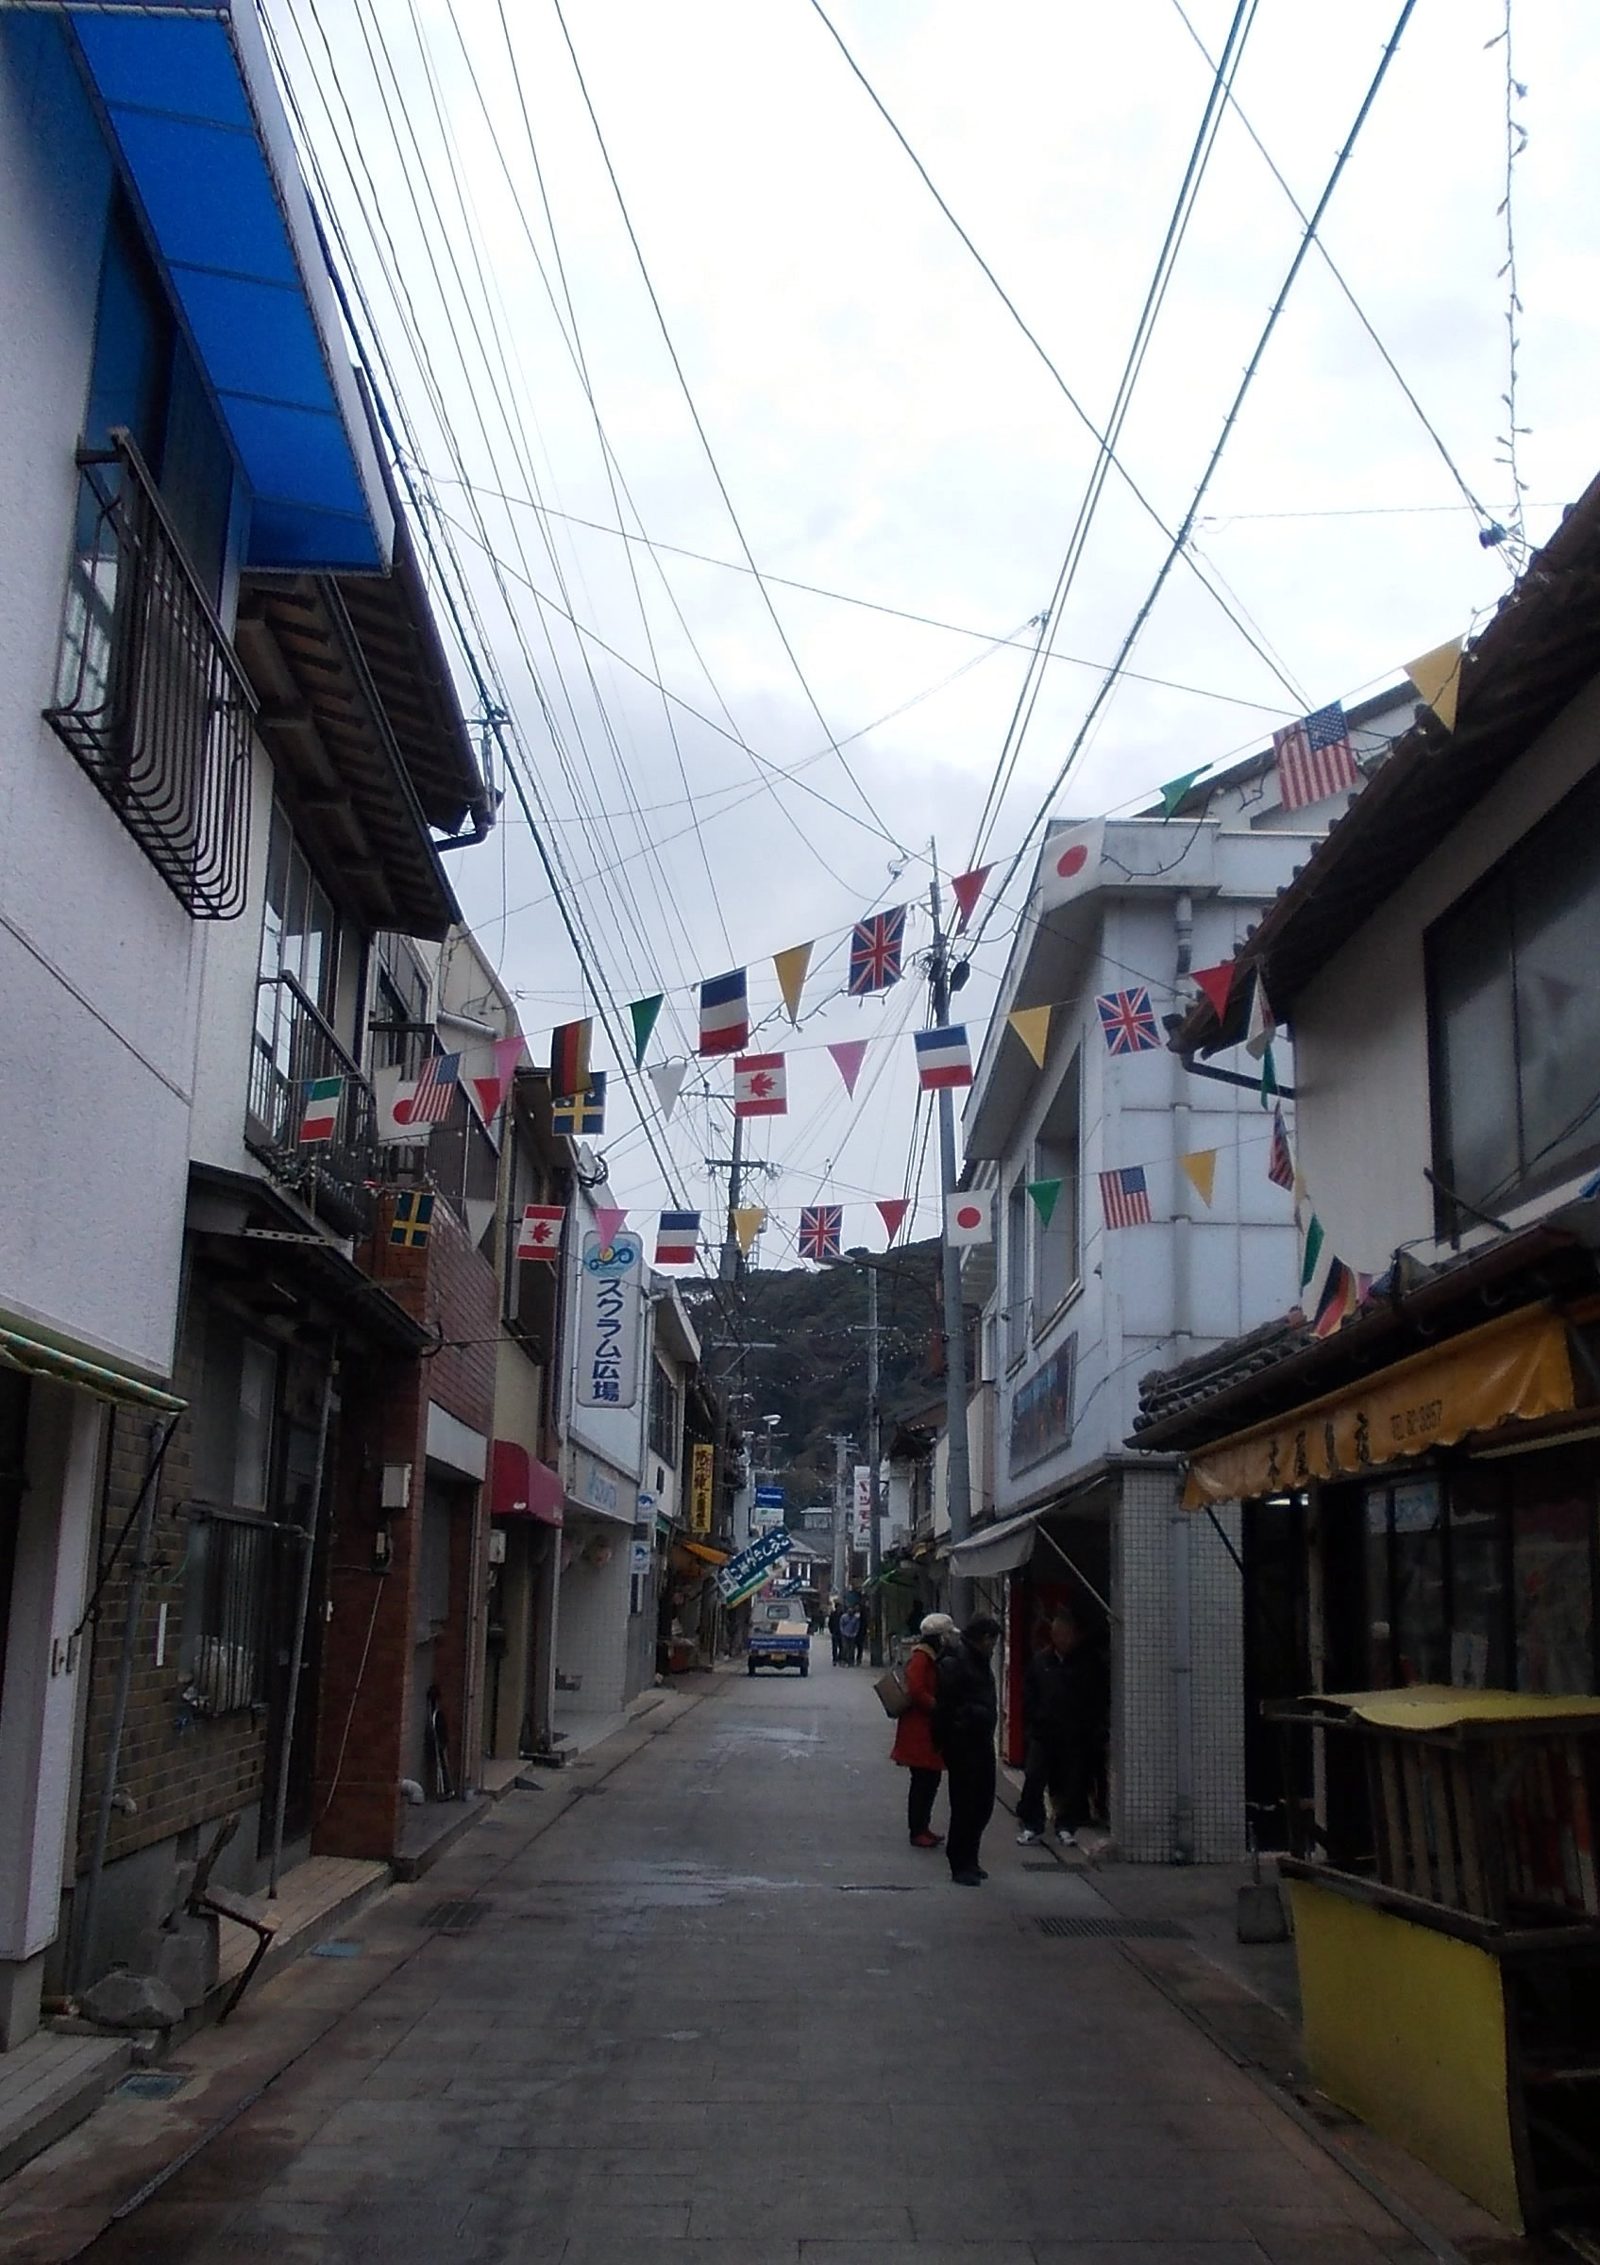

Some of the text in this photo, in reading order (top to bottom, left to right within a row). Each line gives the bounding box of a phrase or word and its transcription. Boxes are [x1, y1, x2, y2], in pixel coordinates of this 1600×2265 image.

[592, 1278, 624, 1403] スクラム広場
